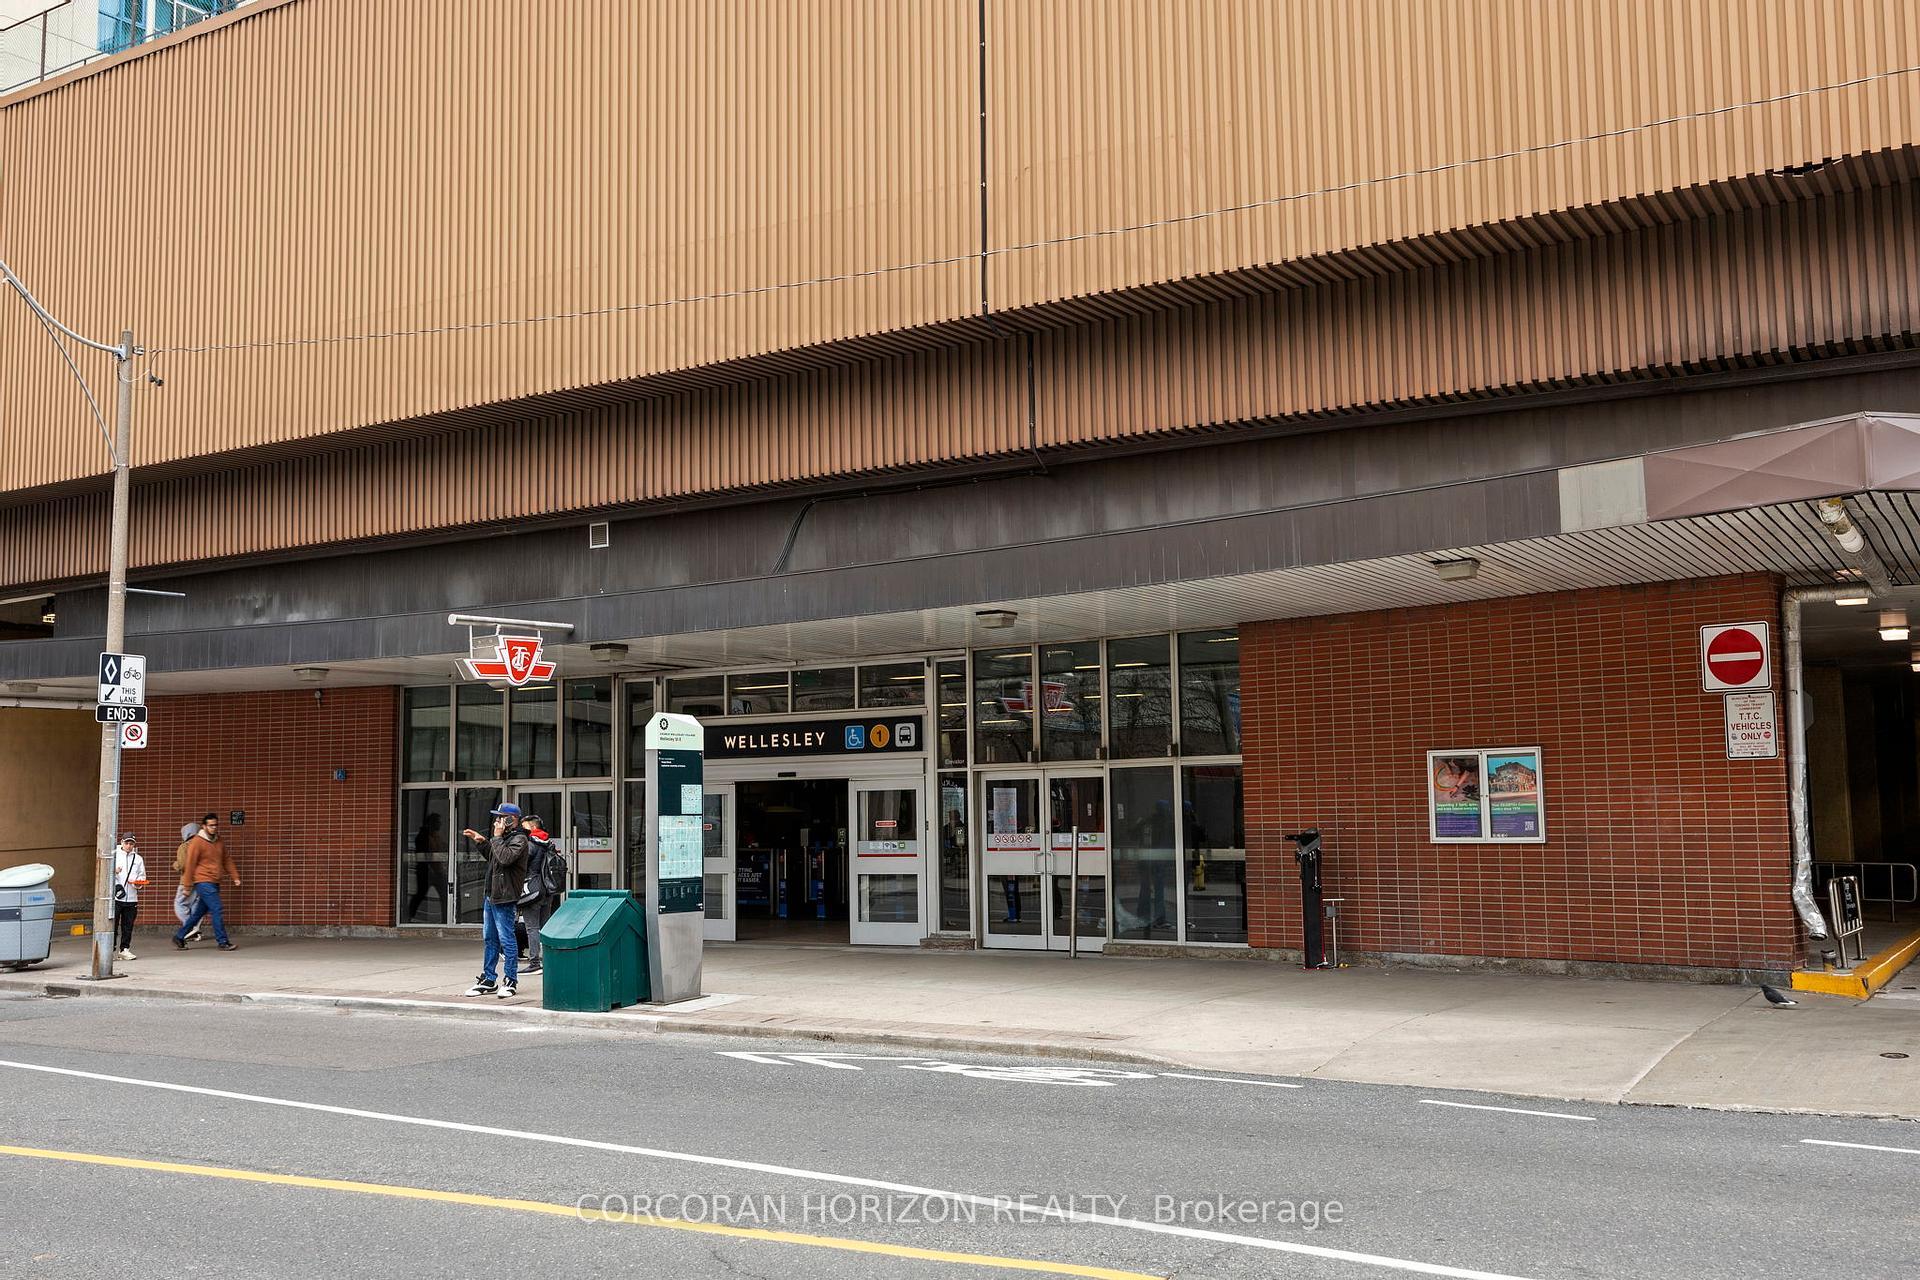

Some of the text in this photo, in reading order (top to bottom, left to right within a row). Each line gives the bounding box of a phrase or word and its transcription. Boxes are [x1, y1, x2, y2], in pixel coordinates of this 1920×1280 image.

[122, 687, 136, 696] THIS
[120, 696, 137, 704] LANE
[106, 708, 136, 720] ENDS
[1739, 712, 1762, 720] T.T.C.
[1730, 722, 1772, 730] VEHICLES
[724, 731, 825, 749] WELLESLEY
[1740, 732, 1762, 740] ONLY
